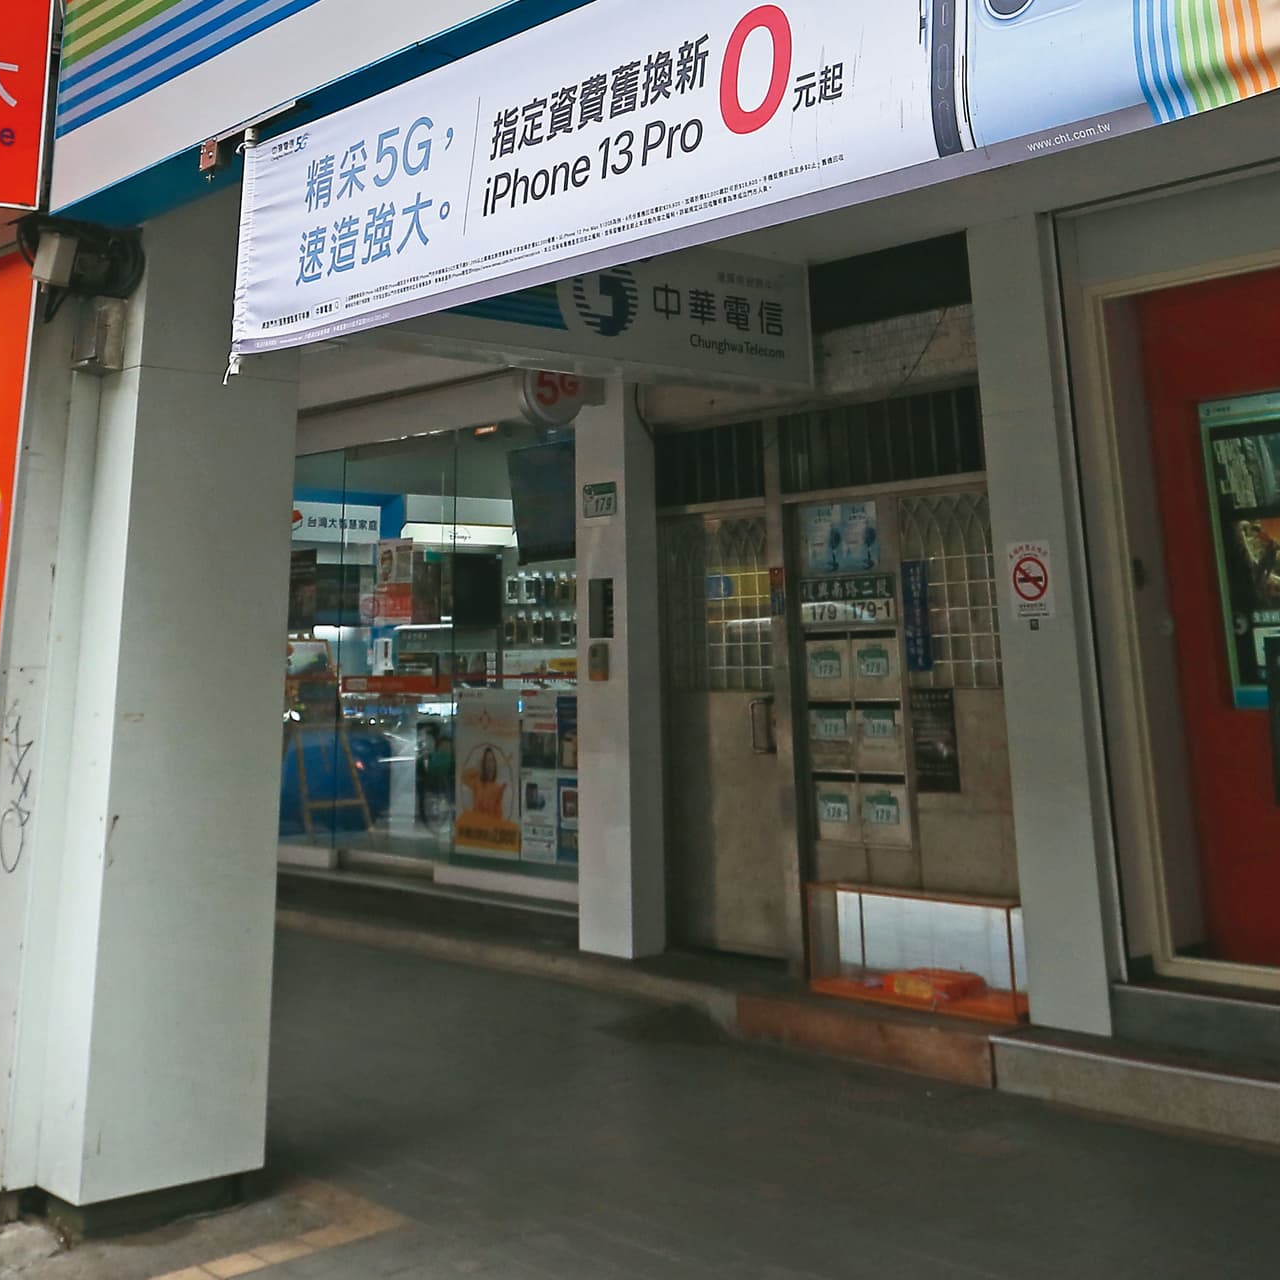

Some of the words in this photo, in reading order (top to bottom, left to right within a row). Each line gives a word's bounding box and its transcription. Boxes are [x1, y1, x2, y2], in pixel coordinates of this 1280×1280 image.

[489, 33, 710, 161] 指定資費舊換新
[719, 4, 793, 135] 0
[792, 62, 844, 112] 元起
[1026, 121, 1113, 153] www.cht.com.tw
[482, 154, 591, 217] iPhone
[598, 129, 634, 180] 13
[641, 117, 704, 167] Pro
[652, 283, 784, 337] 中華電信
[689, 332, 743, 355] Chunghwa
[743, 339, 785, 360] Telecom
[810, 604, 837, 621] 179
